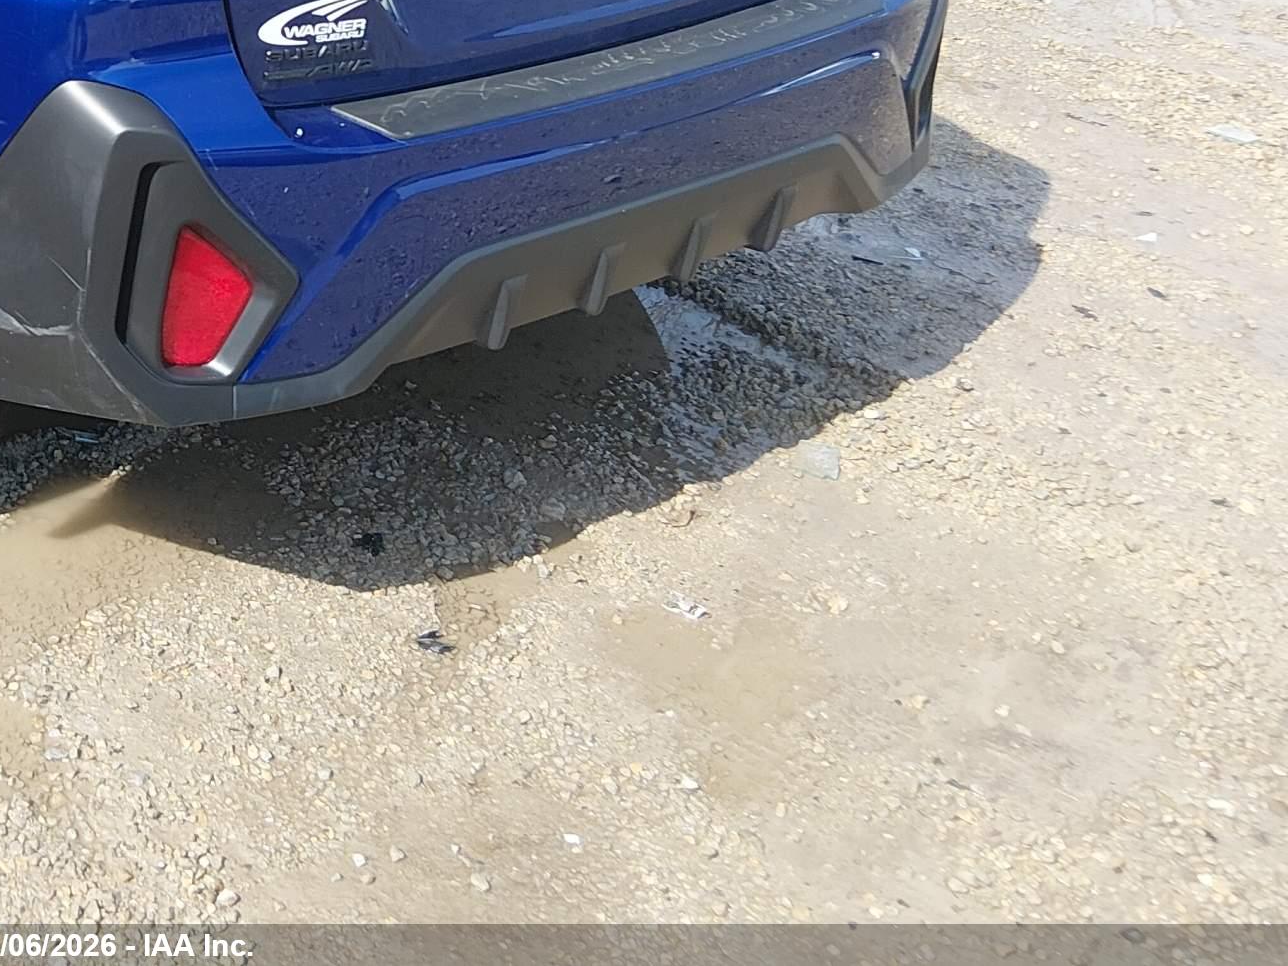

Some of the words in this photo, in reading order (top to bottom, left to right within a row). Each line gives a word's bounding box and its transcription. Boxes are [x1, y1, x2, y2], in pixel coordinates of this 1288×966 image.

[283, 18, 367, 39] WAGNER
[315, 30, 365, 43] SUBARU
[265, 40, 368, 63] SUBARU
